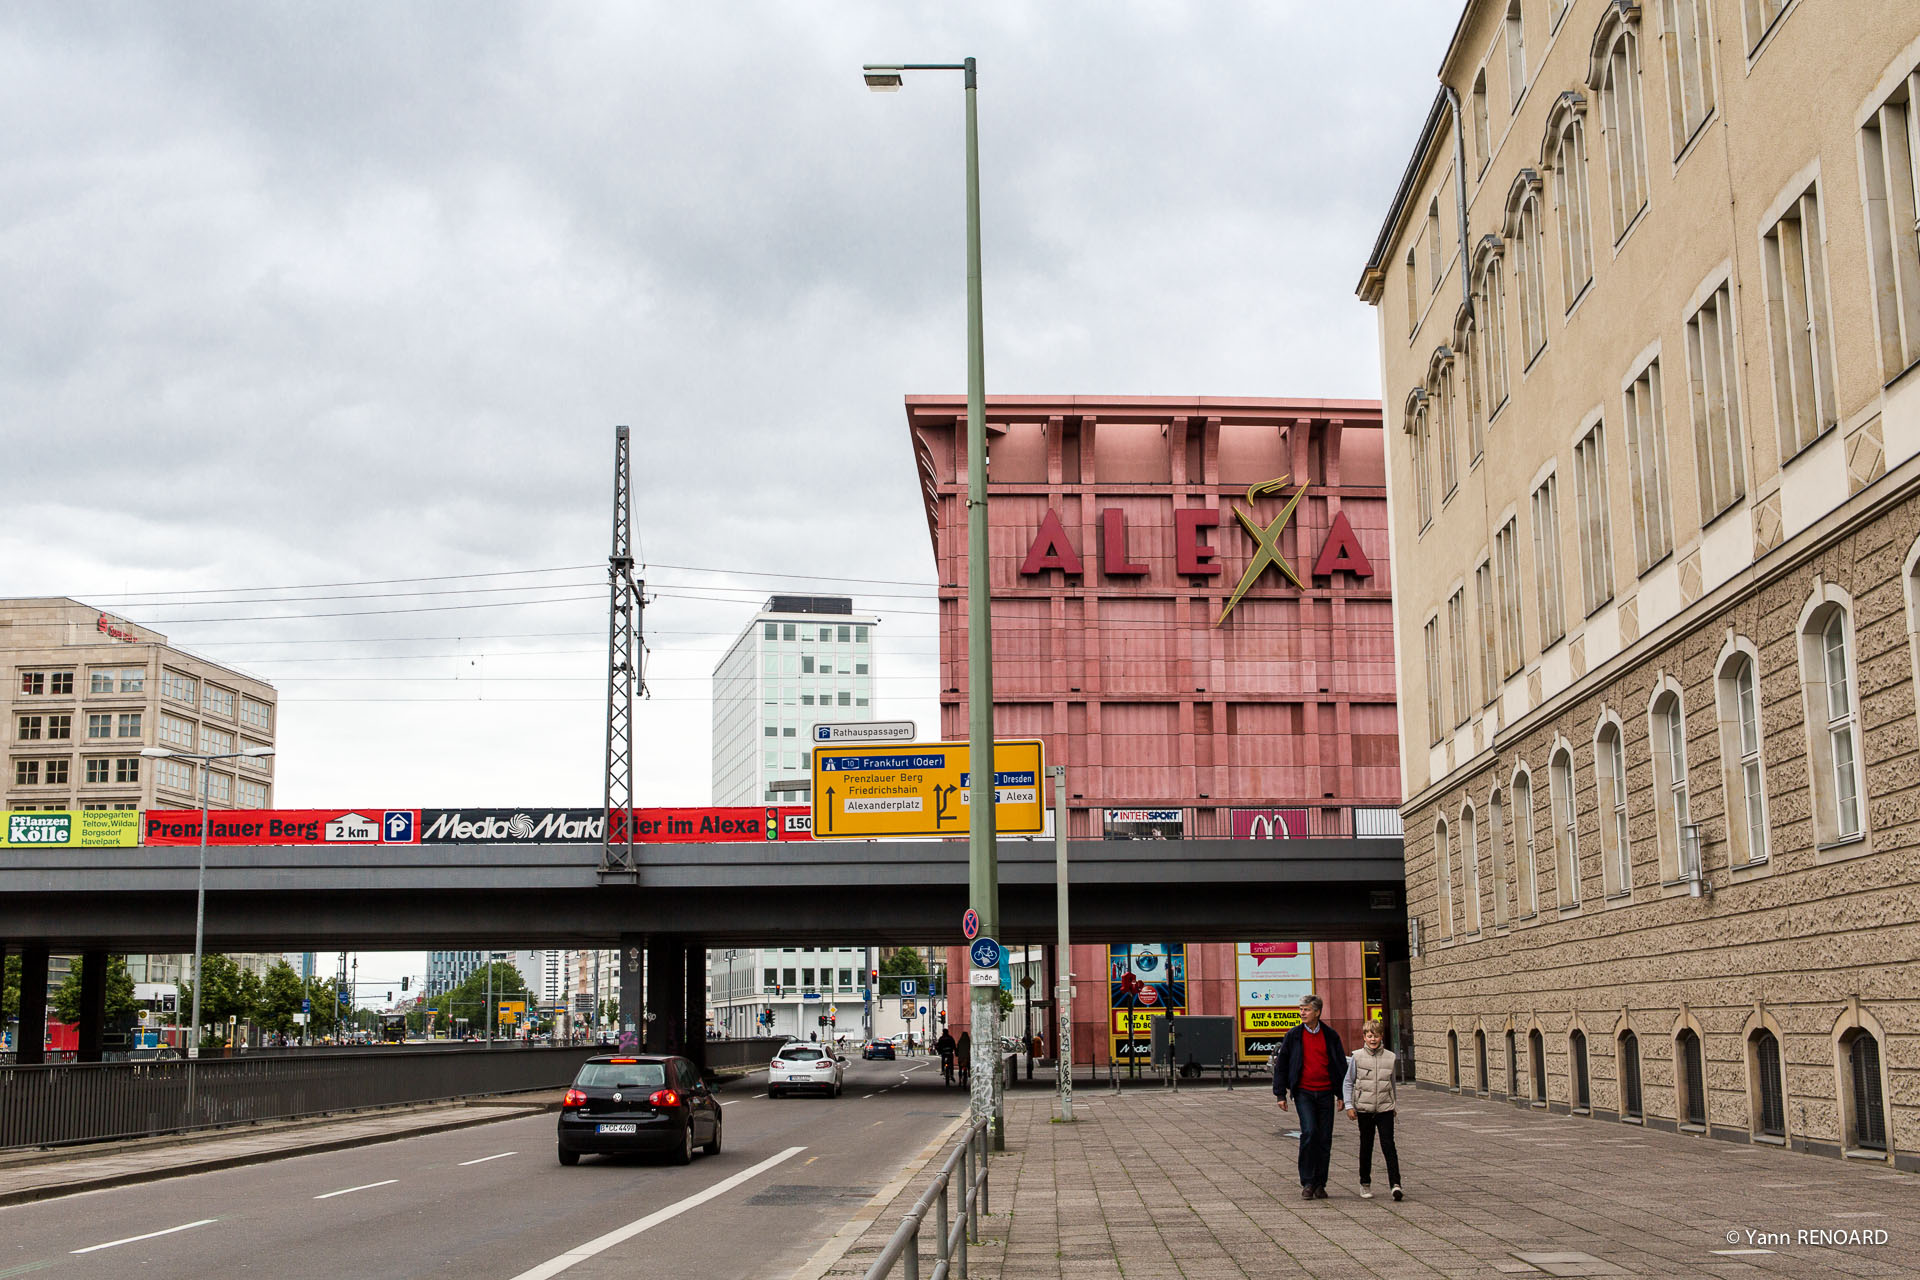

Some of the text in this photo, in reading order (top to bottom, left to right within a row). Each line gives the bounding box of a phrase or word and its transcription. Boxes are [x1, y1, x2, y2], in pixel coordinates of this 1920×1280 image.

[1020, 479, 1374, 627] ALEXA
[833, 727, 909, 738] Rathauspassagen
[863, 758, 909, 768] Frankfurt
[913, 756, 942, 767] (Oder)
[844, 772, 923, 784] Prenzlauer Berg
[1003, 774, 1032, 784] Dresden
[849, 785, 918, 795] Friedrichshain
[1006, 791, 1033, 801] Alexa
[847, 799, 920, 811] Alexanderplatz
[82, 811, 134, 820] Hoppegarten
[1120, 811, 1179, 821] INTERSPORT
[11, 816, 69, 827] Pflanzen
[422, 813, 510, 839] Media
[667, 816, 693, 834] im
[700, 816, 759, 834] Alexa
[788, 817, 811, 830] 150
[10, 826, 69, 843] Kölle
[82, 829, 122, 837] Borgsdorf
[269, 819, 319, 840] Berg
[335, 826, 369, 838] 2 km
[81, 838, 121, 846] Havelpark
[1254, 945, 1276, 953] smart?
[975, 973, 993, 981] Ende
[904, 981, 913, 993] U
[1251, 1012, 1266, 1020] AUF
[1267, 1012, 1273, 1020] 4
[1253, 1020, 1269, 1028] UND
[1248, 1042, 1276, 1052] Media
